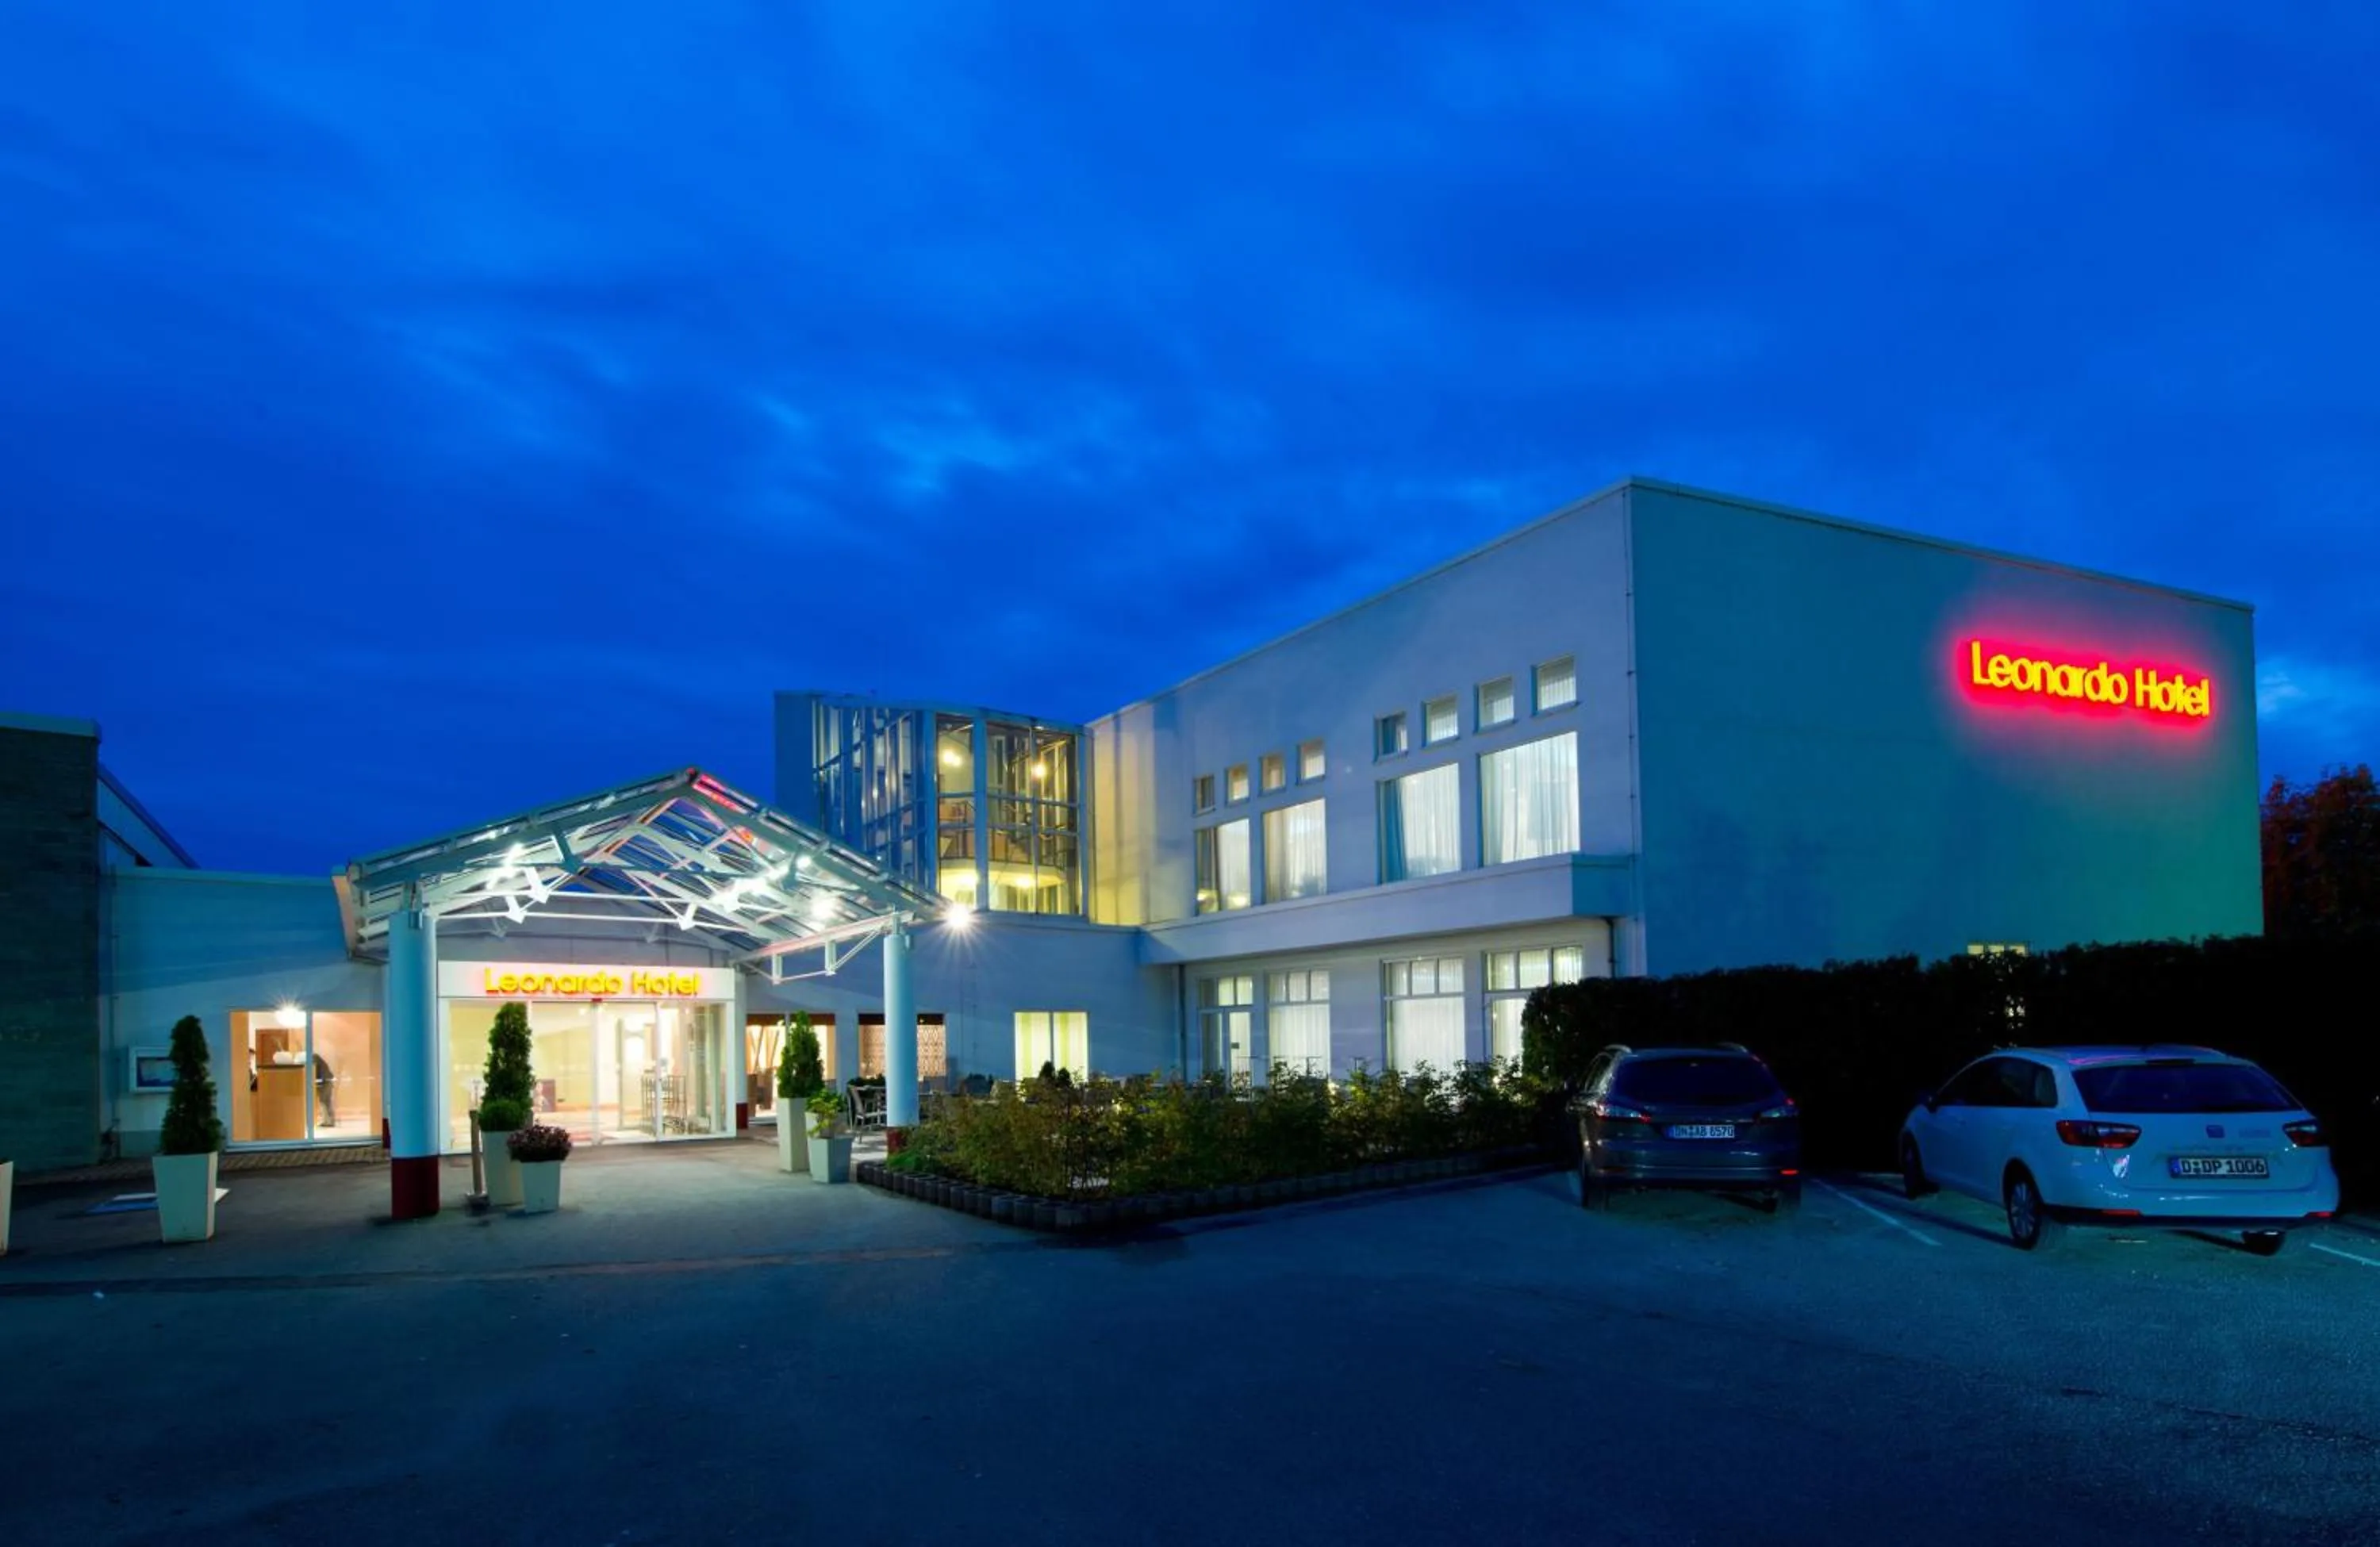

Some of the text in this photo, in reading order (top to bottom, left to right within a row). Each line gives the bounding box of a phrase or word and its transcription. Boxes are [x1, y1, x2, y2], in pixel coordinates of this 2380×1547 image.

[1971, 640, 2210, 717] Leonardo Hotel
[484, 967, 700, 996] Leonardo Hotel
[2225, 1160, 2265, 1173] 1006
